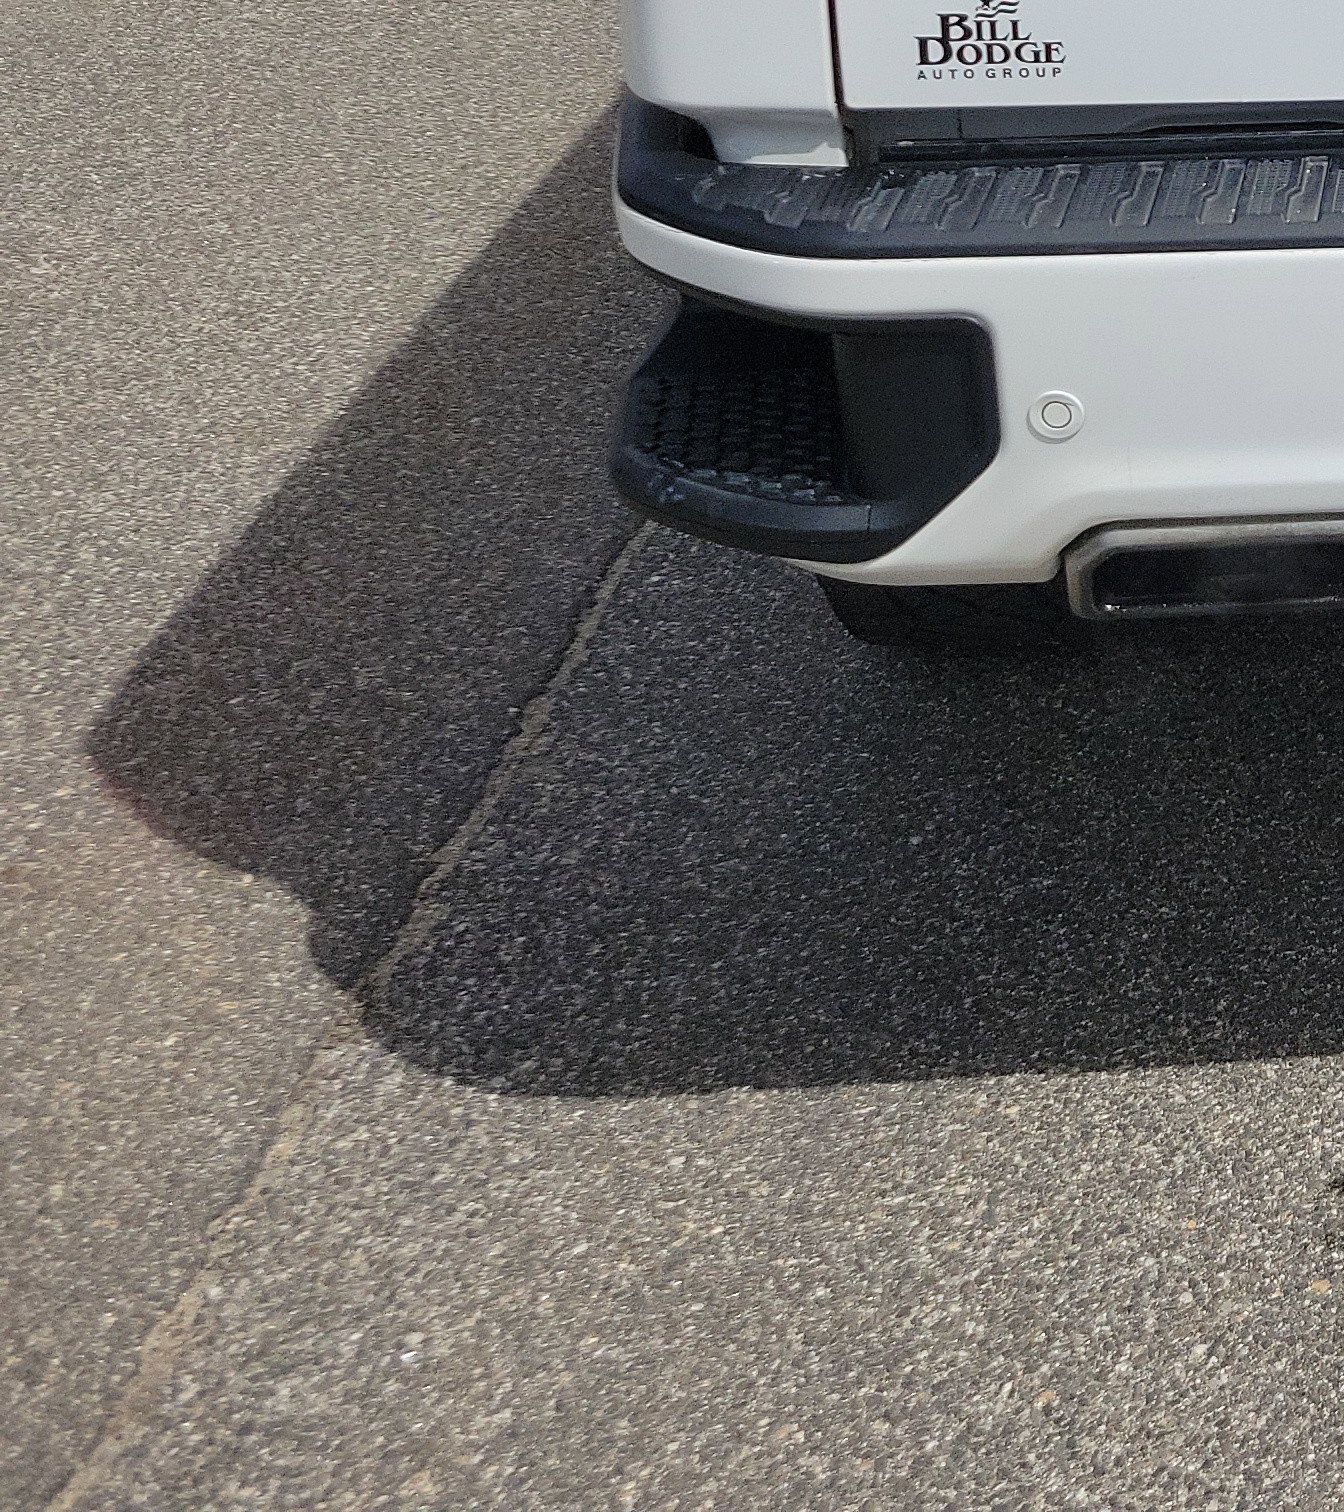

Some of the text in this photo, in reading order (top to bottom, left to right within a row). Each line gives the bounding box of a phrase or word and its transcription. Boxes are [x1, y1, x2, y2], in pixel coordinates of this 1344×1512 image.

[936, 12, 1032, 42] BILL
[914, 35, 1067, 66] DODGE
[917, 67, 1063, 81] AUTO GROUP
